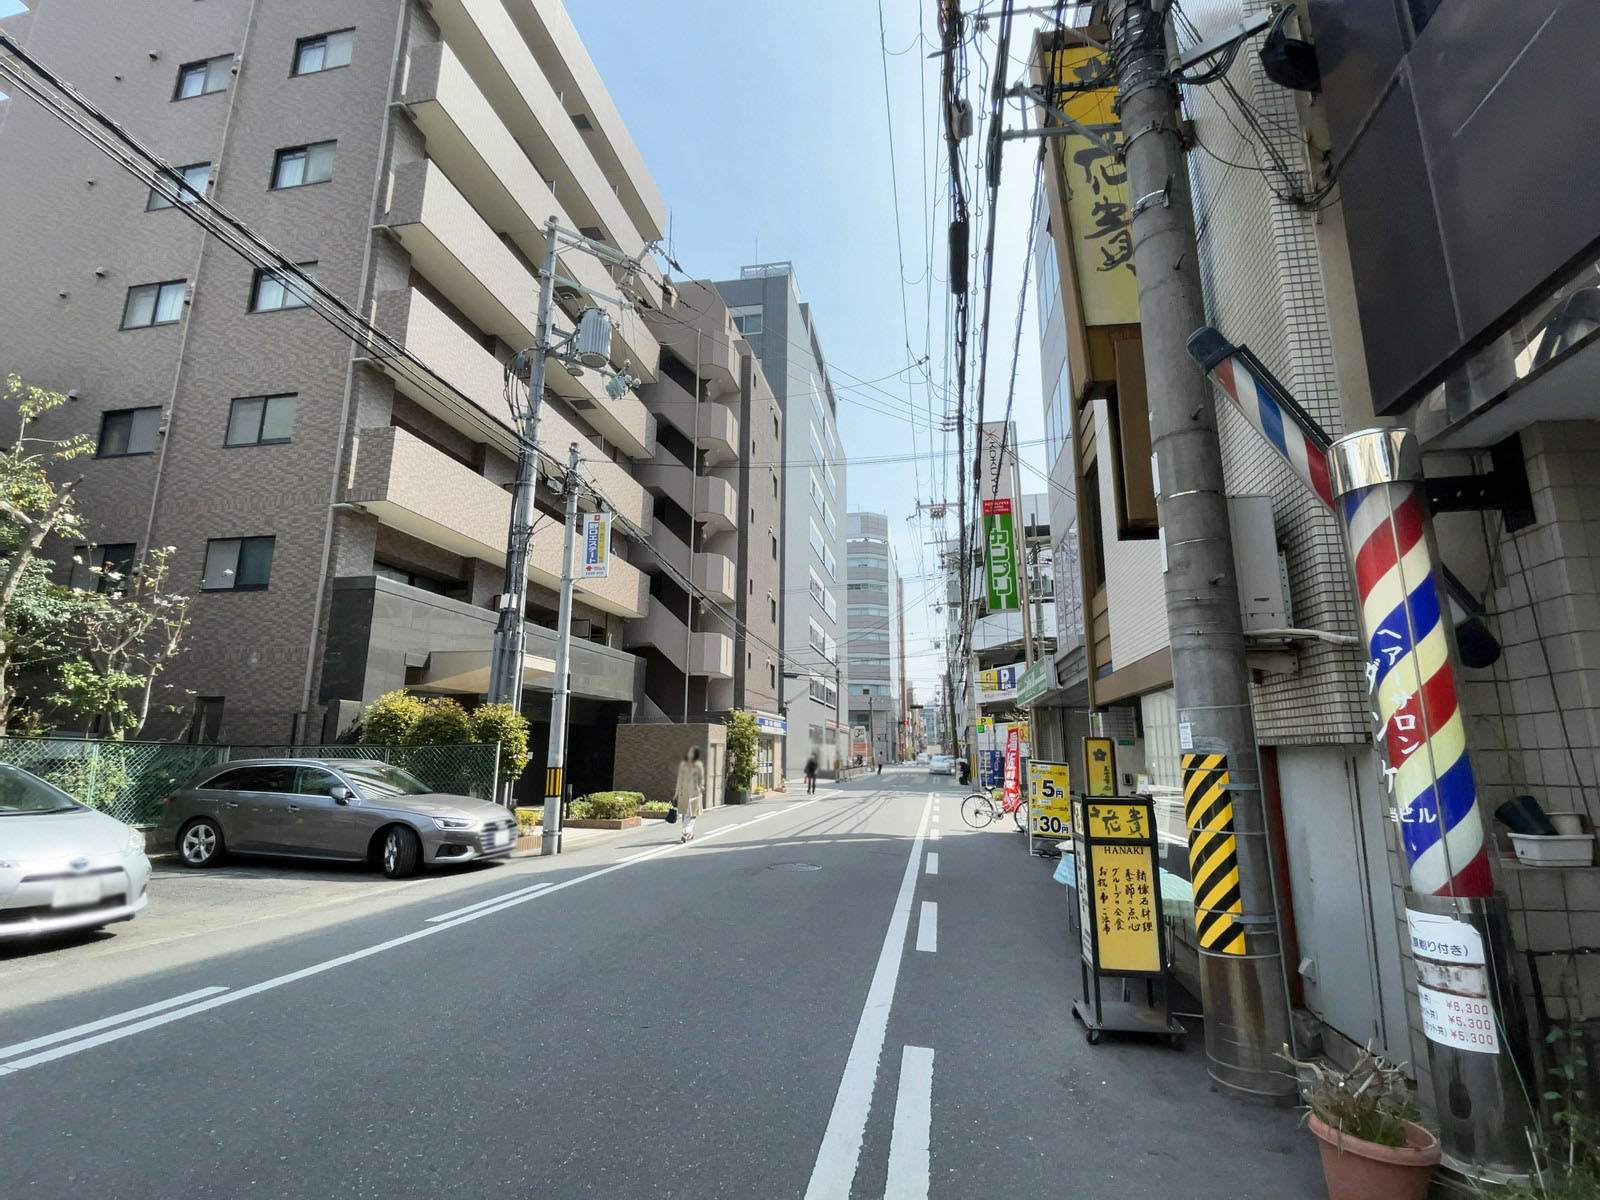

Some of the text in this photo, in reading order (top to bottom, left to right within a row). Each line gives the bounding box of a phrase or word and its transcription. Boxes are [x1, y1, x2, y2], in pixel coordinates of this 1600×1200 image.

[988, 441, 998, 494] KOKUYO
[1376, 628, 1420, 755] ヘアーサロン
[1365, 658, 1399, 794] ダンケ
[1103, 846, 1144, 855] HANAKI
[1112, 867, 1125, 930] グループの会食
[1125, 868, 1141, 932] 季節の点心
